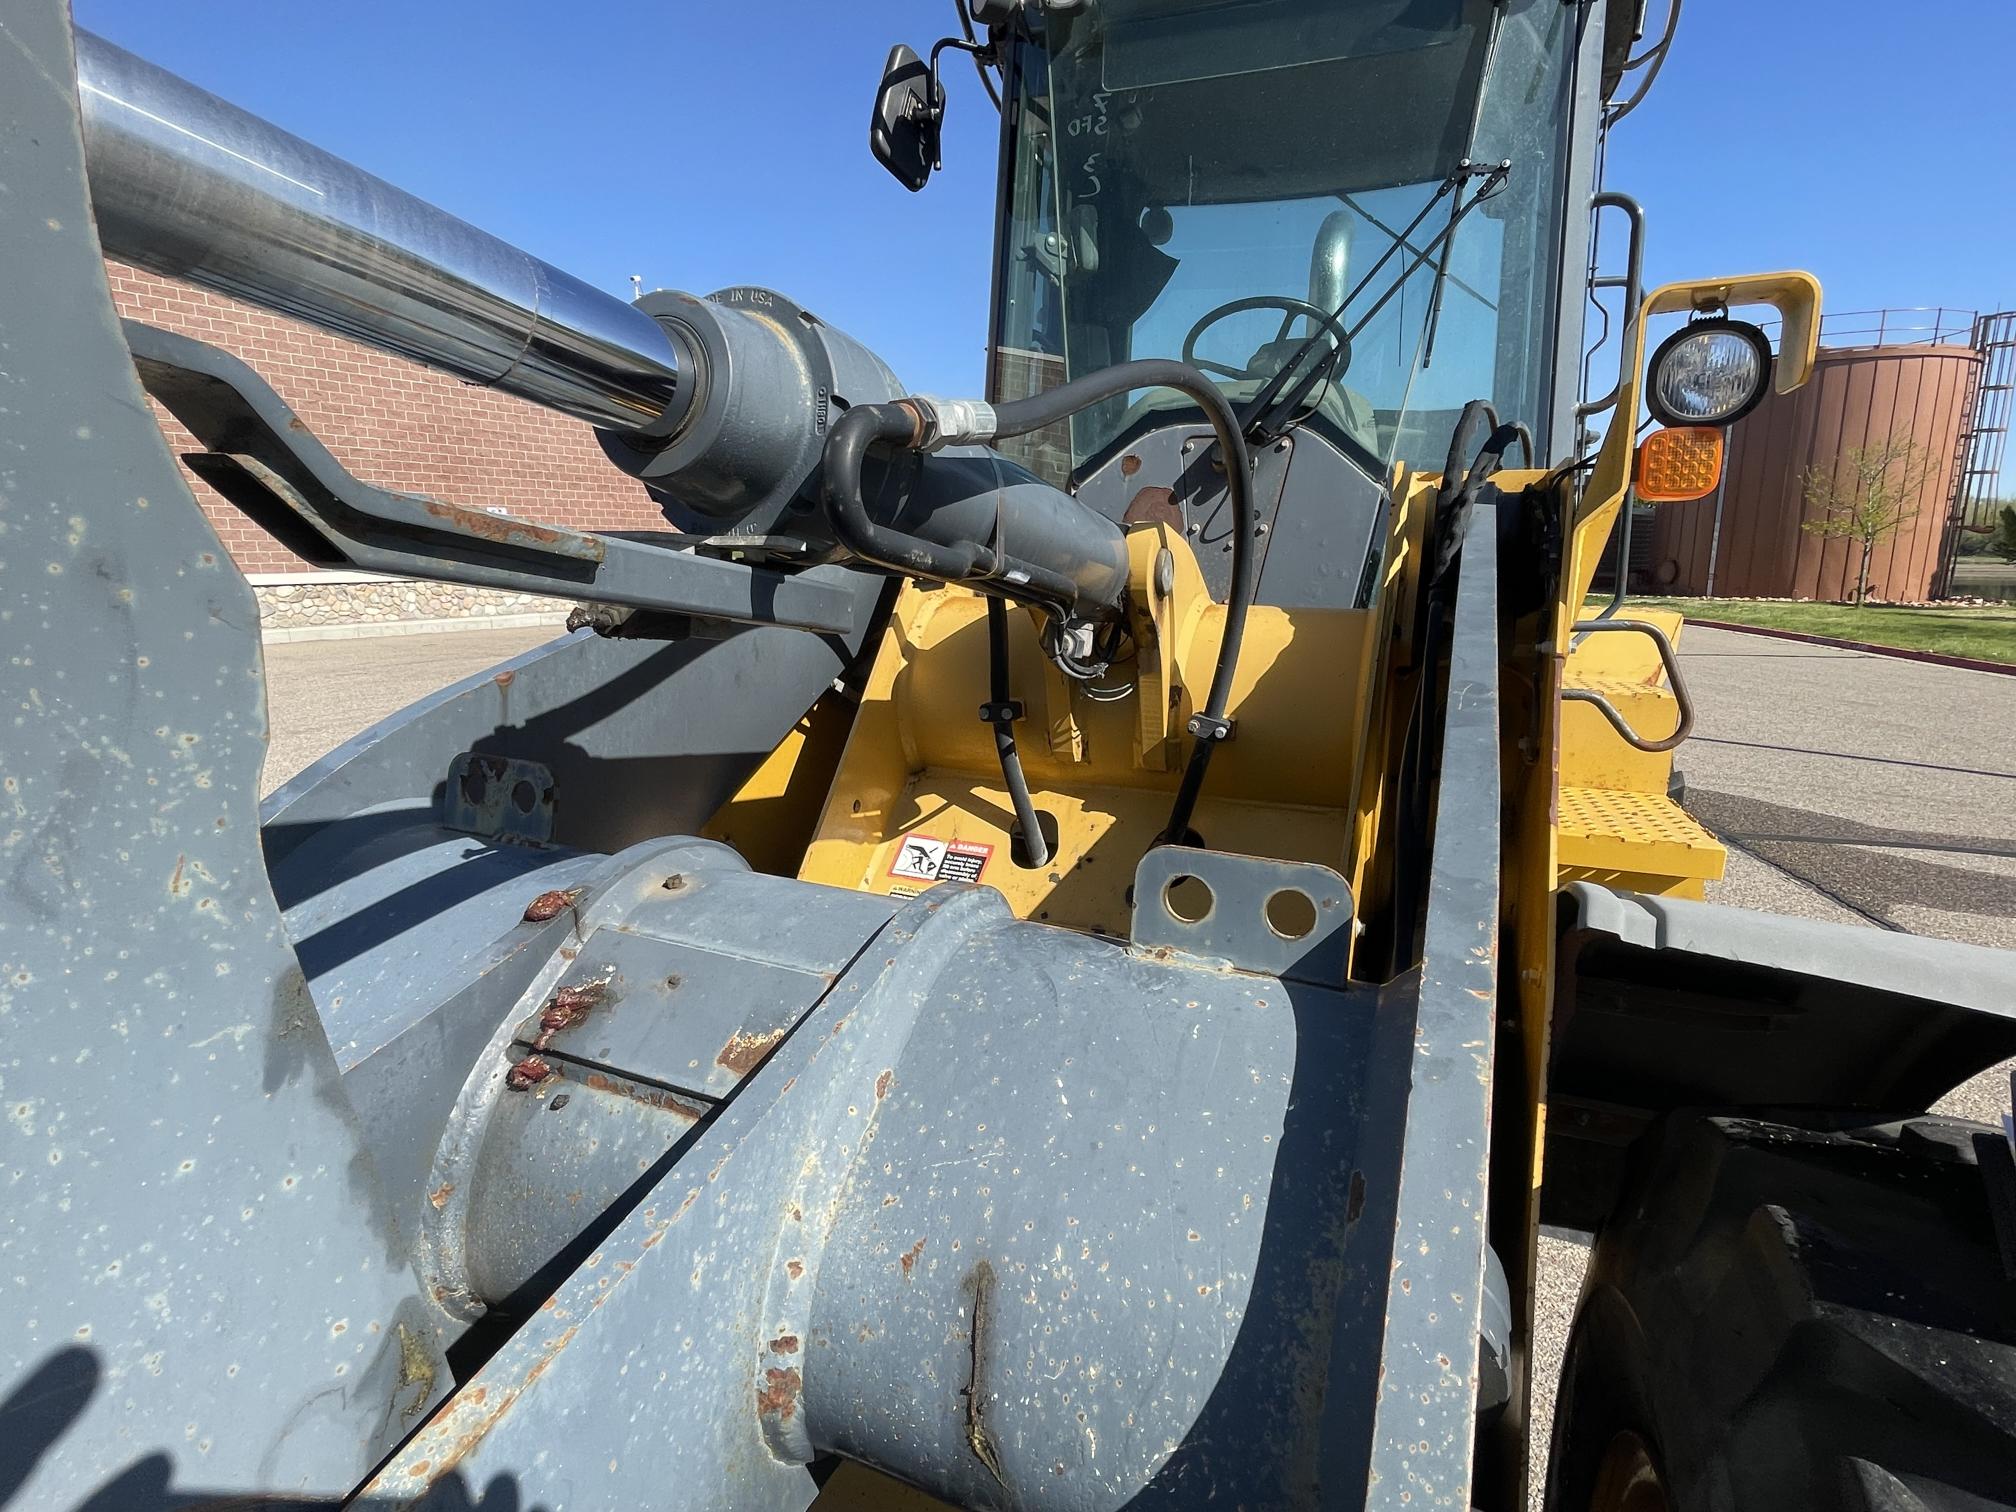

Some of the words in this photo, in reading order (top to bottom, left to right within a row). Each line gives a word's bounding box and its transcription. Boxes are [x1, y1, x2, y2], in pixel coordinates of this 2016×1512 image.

[731, 288, 744, 302] IN
[750, 288, 775, 308] USA
[957, 843, 989, 854] DANGER
